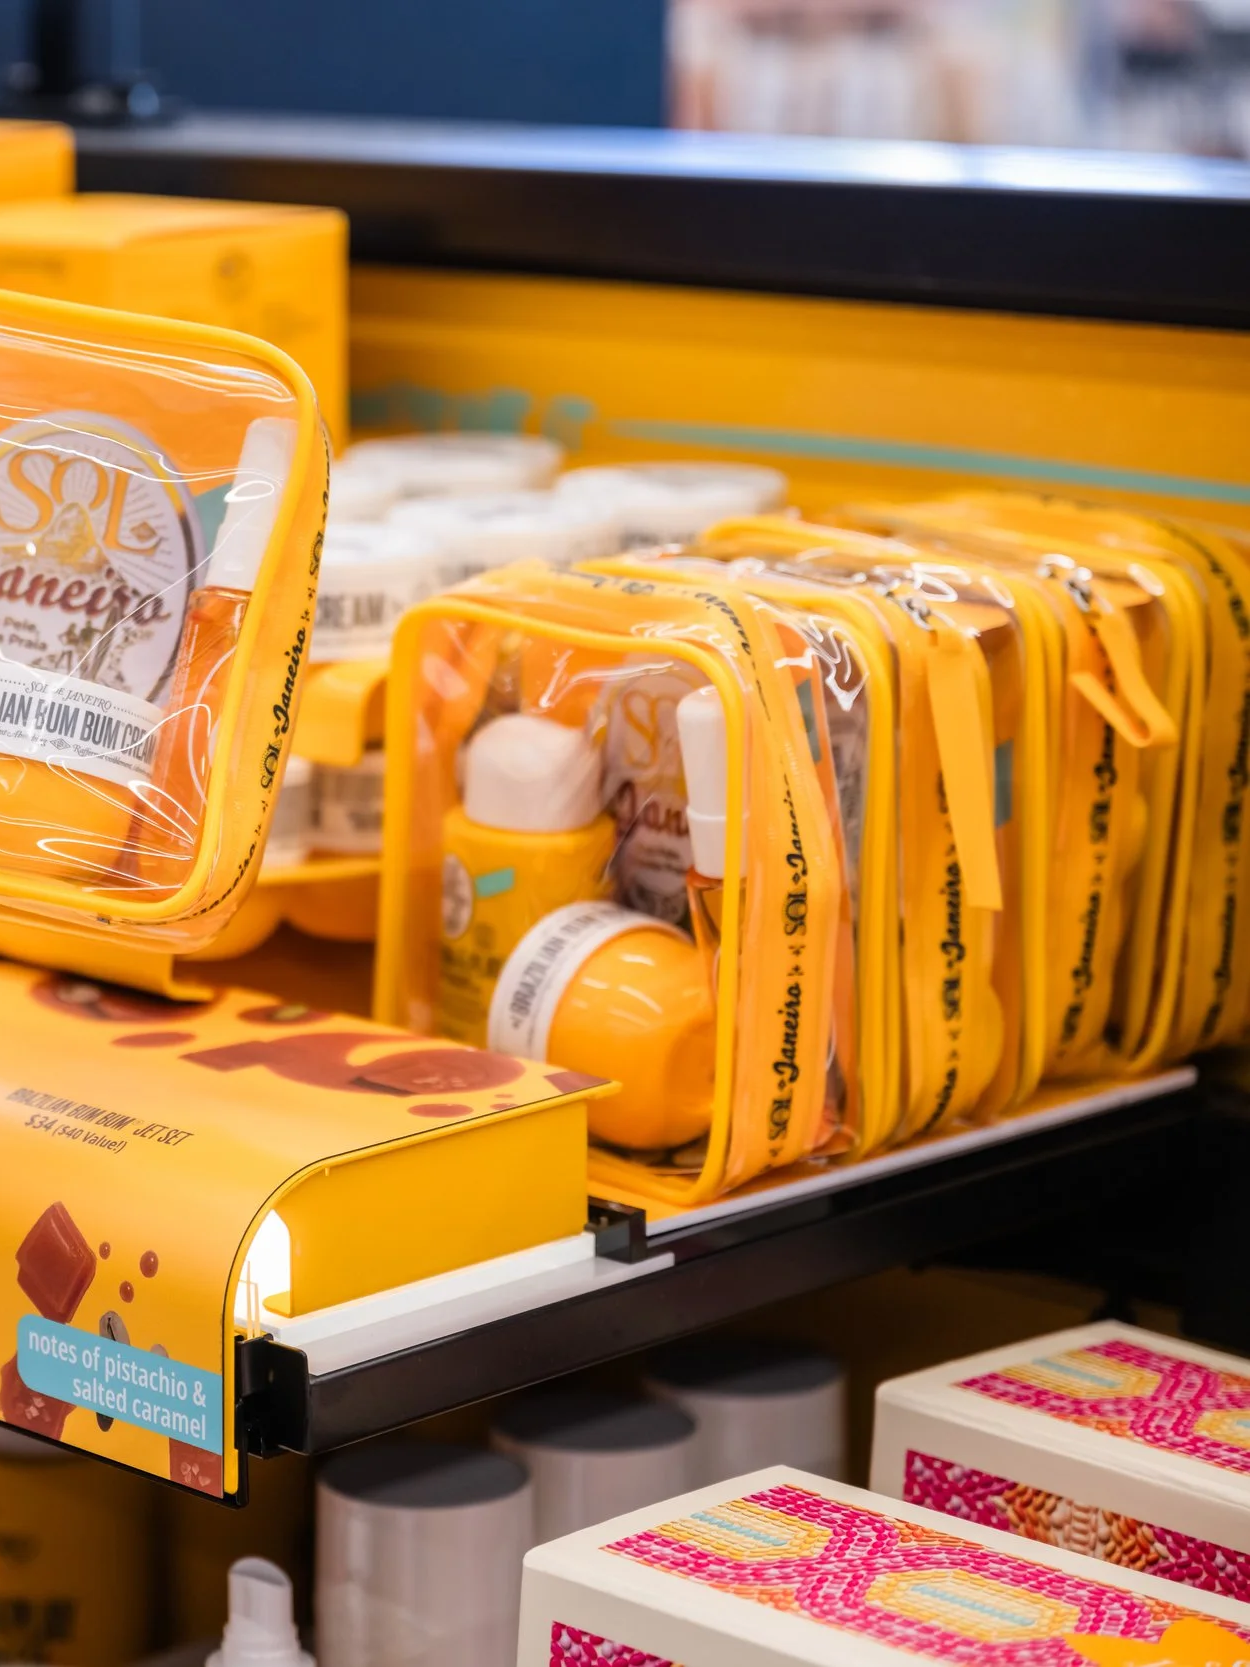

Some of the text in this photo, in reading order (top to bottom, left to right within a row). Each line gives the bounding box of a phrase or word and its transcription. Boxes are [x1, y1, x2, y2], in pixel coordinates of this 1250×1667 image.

[272, 626, 307, 735] Janeiro
[35, 698, 80, 739] BUM
[785, 882, 808, 938] SOL
[772, 982, 803, 1083] Janeiro
[24, 1113, 129, 1154] $34 ($40 Value!)
[65, 1104, 107, 1123] BUM
[132, 1122, 169, 1140] JET
[156, 1128, 195, 1147] SET
[768, 1087, 794, 1141] SOL
[28, 1330, 207, 1409] notes of pistachio &
[72, 1377, 207, 1441] salted caramel
